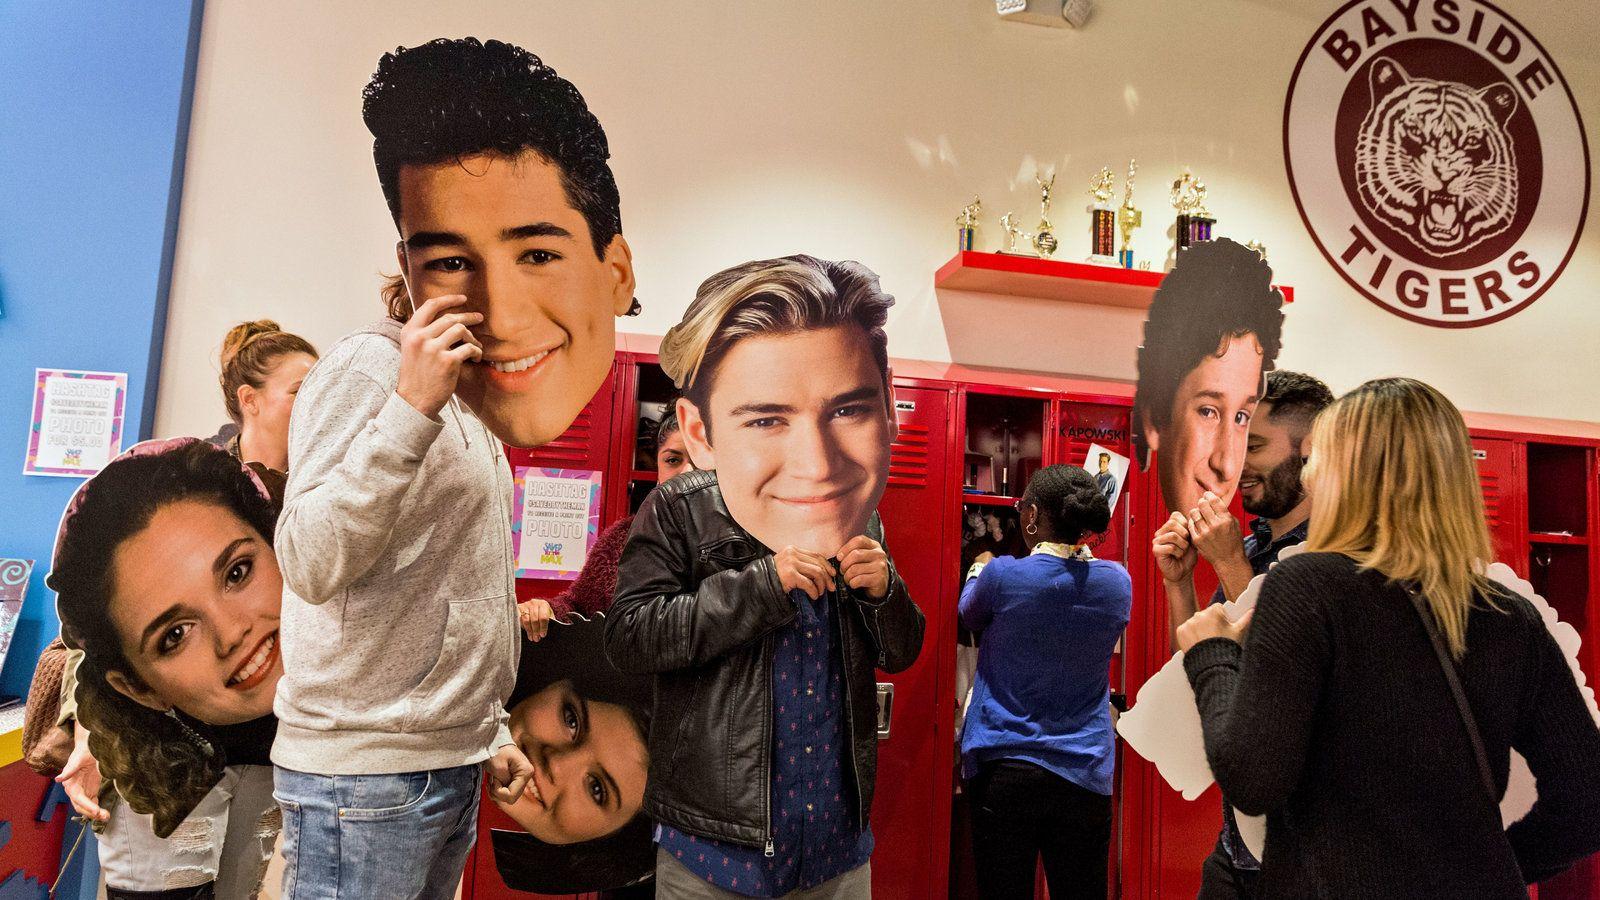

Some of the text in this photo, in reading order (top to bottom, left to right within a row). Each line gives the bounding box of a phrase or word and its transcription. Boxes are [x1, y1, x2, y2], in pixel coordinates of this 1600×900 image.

[1322, 0, 1554, 101] BAYSIDE
[1341, 224, 1541, 315] TIGERS
[51, 381, 110, 398] HASHTAG
[48, 417, 105, 435] PHOTO
[1059, 427, 1127, 440] KAPOWSKI
[48, 435, 68, 446] FOR
[528, 481, 586, 499] HASHTAG
[526, 520, 583, 539] PHOTO
[543, 543, 562, 551] SAVED
[541, 554, 562, 565] MAX
